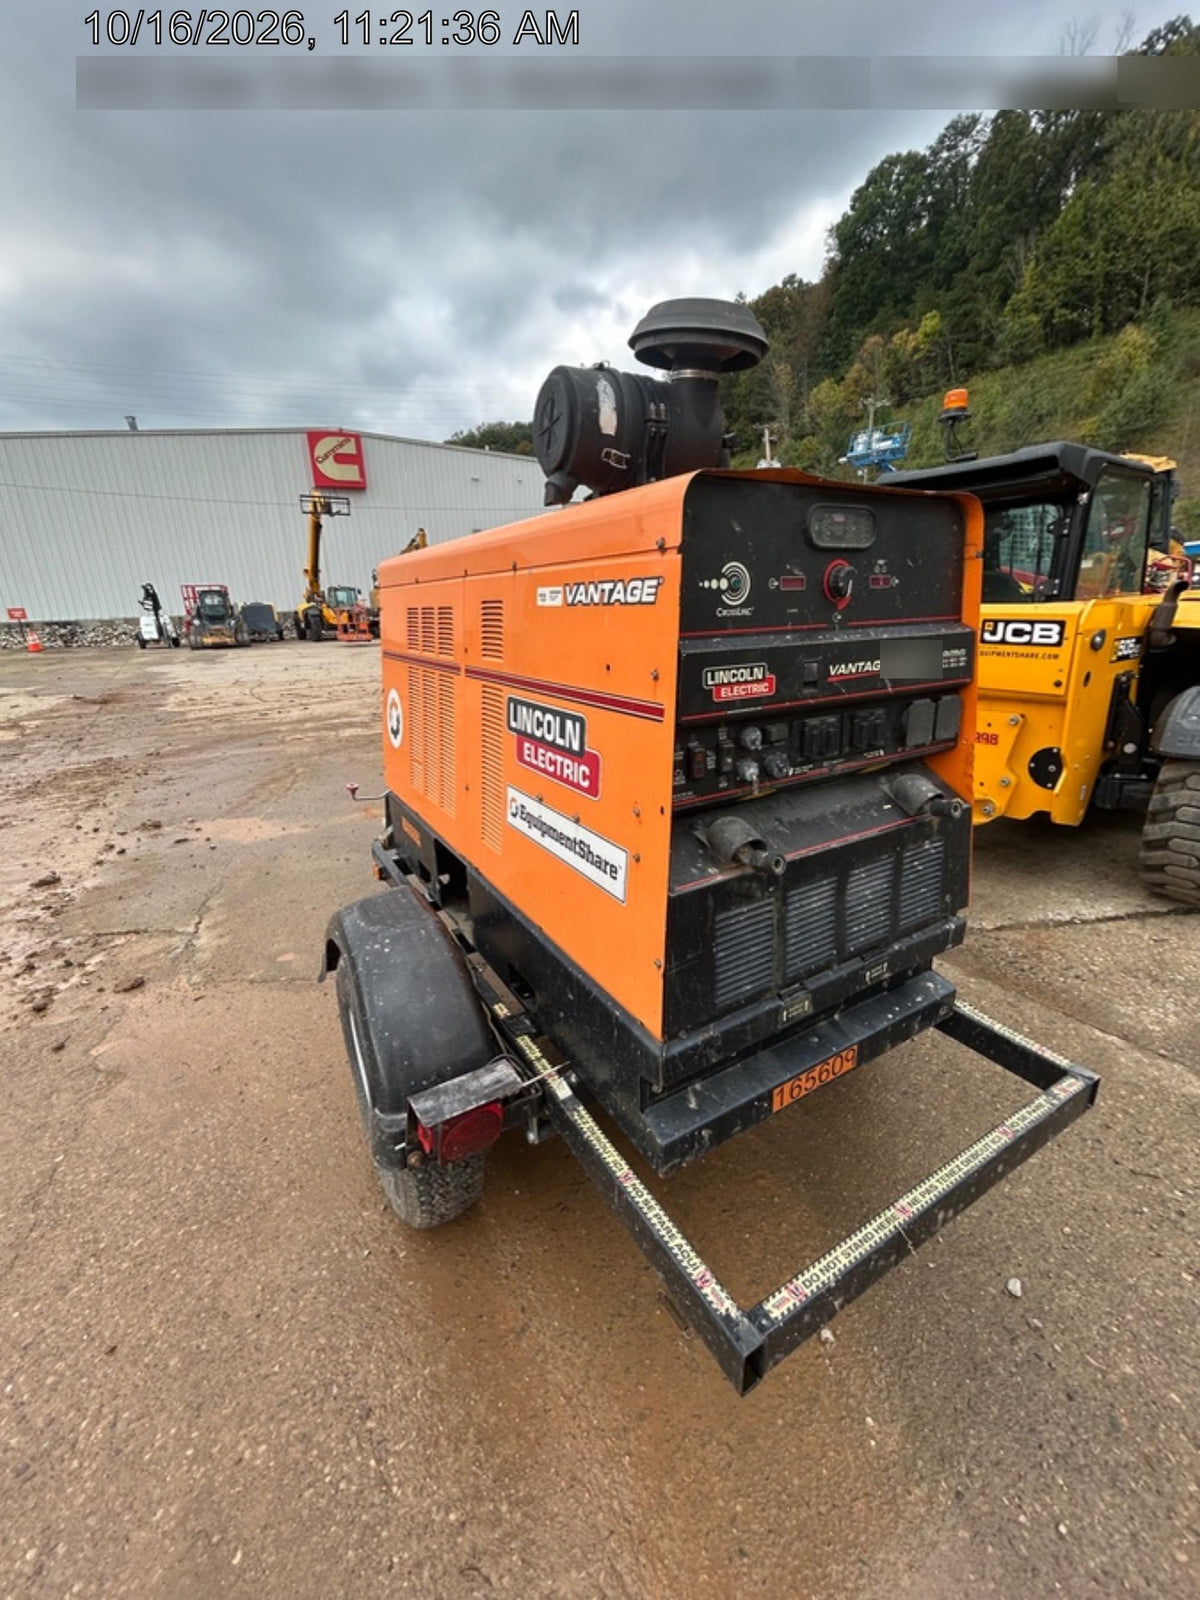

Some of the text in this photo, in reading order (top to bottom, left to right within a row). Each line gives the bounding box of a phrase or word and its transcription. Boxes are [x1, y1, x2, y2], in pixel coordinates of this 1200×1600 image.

[564, 577, 660, 606] VANTAGE
[983, 621, 1060, 644] JCB
[706, 666, 764, 685] LINCOLN
[721, 683, 769, 697] ELECTRIC
[829, 660, 880, 676] VANTAG
[509, 702, 581, 751] LINCOLN
[523, 742, 590, 788] ELECTRIC
[519, 803, 618, 881] EquipmentShare
[776, 1048, 856, 1107] 165609
[629, 1181, 645, 1199] NO
[640, 1196, 656, 1214] SE
[651, 1211, 679, 1243] PARE
[801, 1209, 900, 1290] DO NOT STAND HERE
